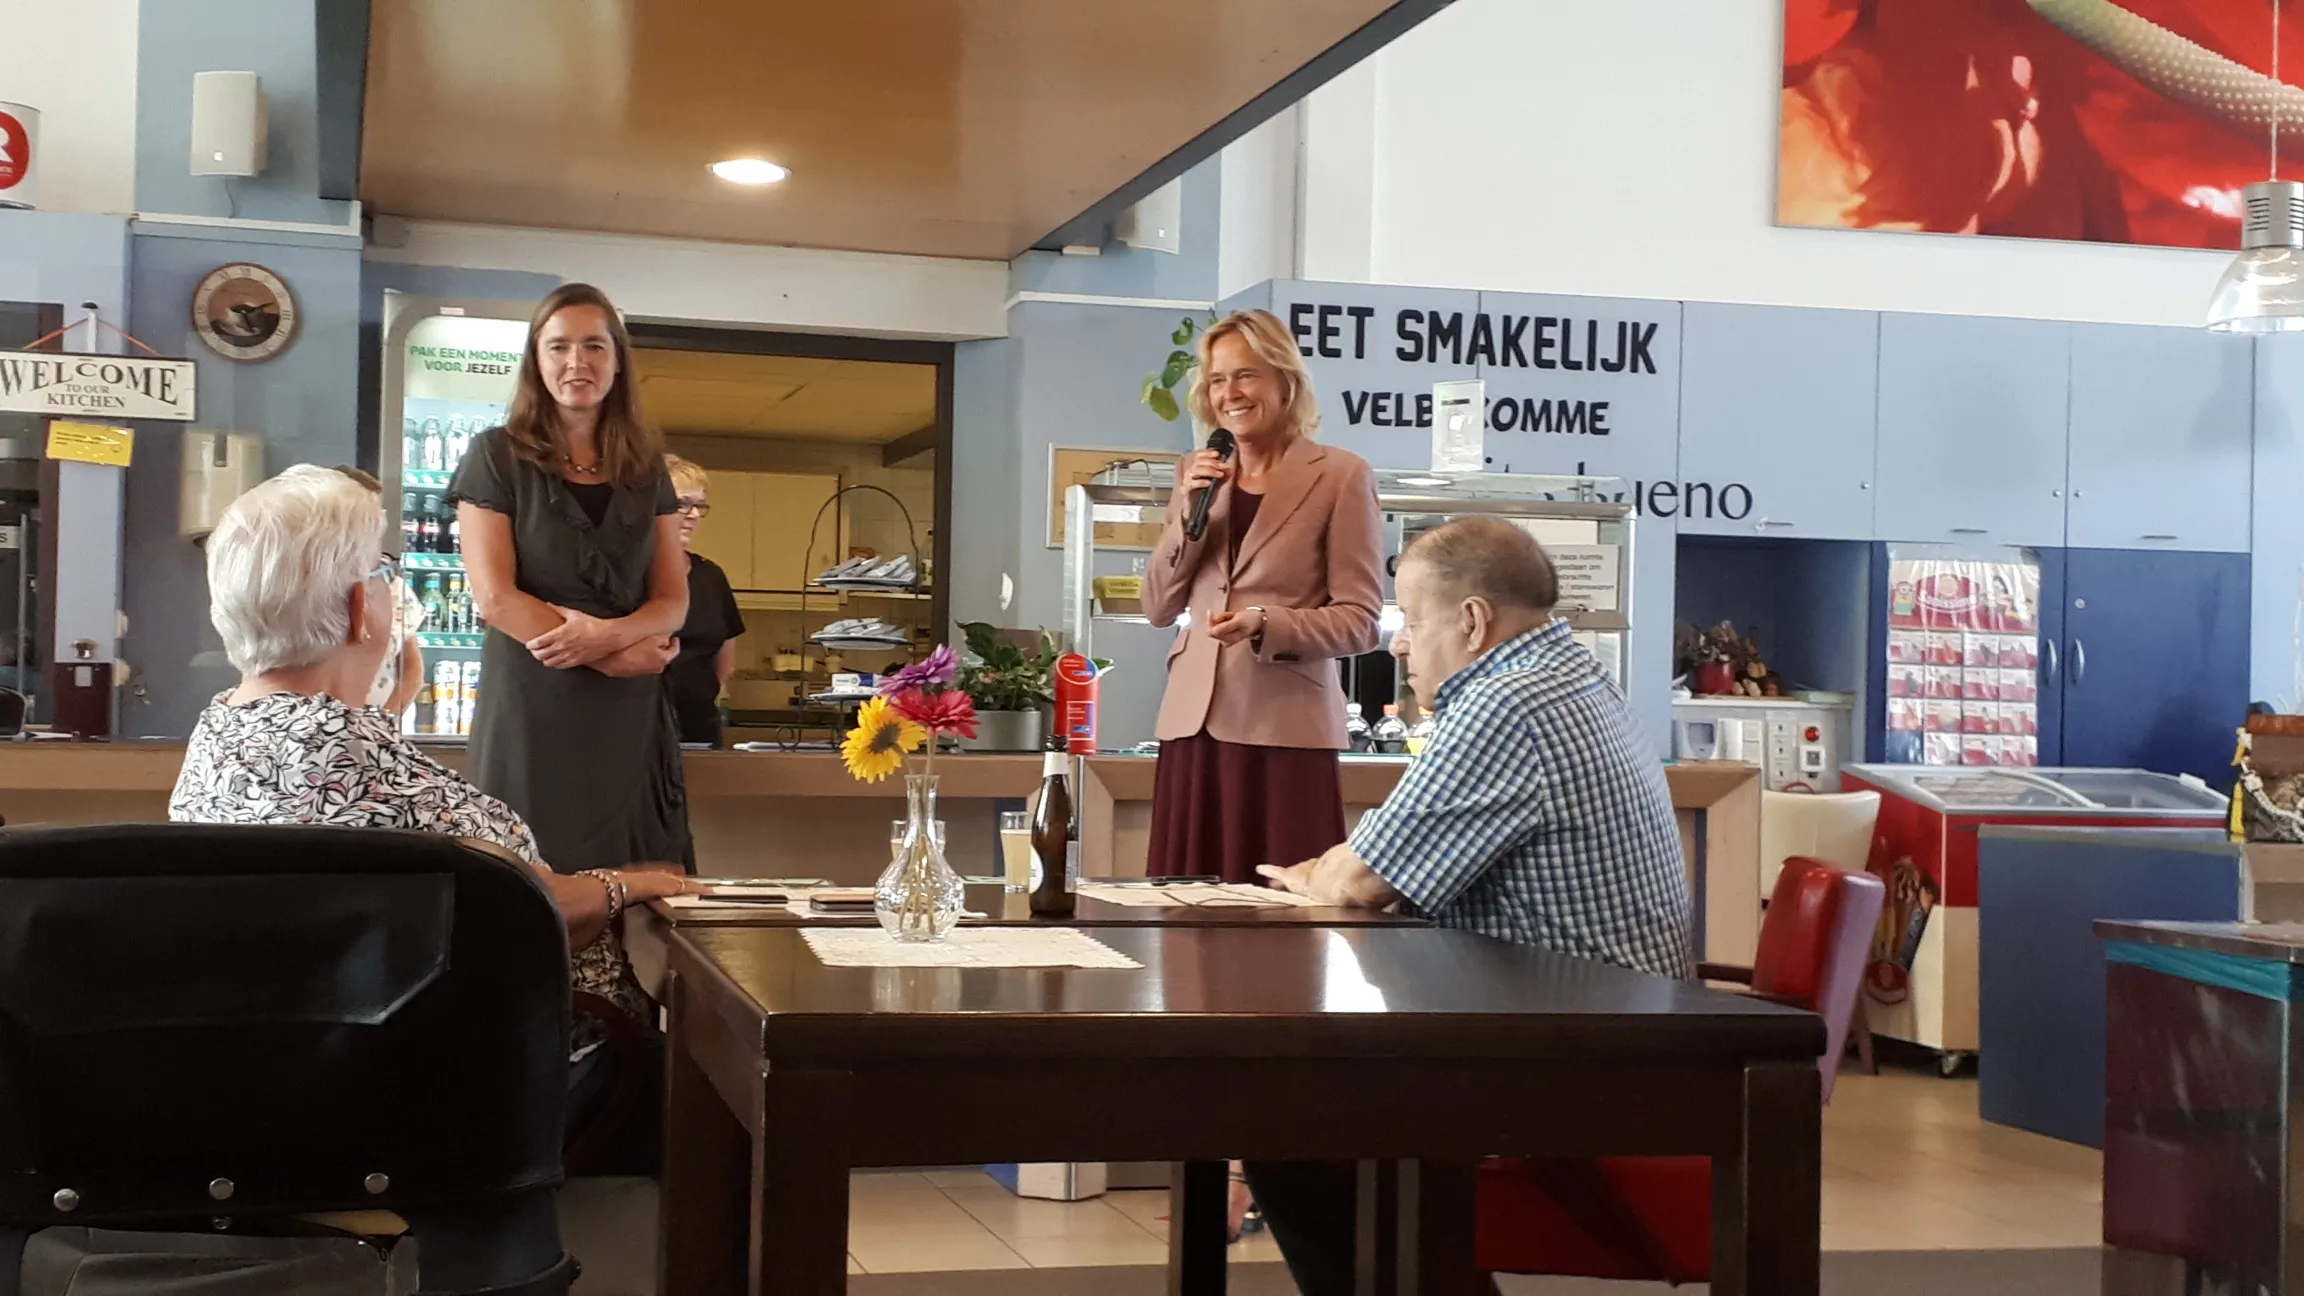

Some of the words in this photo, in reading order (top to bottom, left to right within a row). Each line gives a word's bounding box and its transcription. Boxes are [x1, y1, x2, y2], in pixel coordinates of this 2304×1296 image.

[1290, 303, 1375, 359] EET
[1396, 309, 1658, 374] SMAKELIJK
[410, 345, 436, 357] PAK
[440, 347, 466, 359] EEN
[424, 360, 462, 372] VOOR
[465, 363, 512, 375] JEZELF
[0, 358, 179, 406] WELCOME
[65, 383, 81, 393] TO
[83, 384, 110, 394] OUR
[47, 393, 127, 409] KITCHEN
[1341, 390, 1611, 436] VELBOMME
